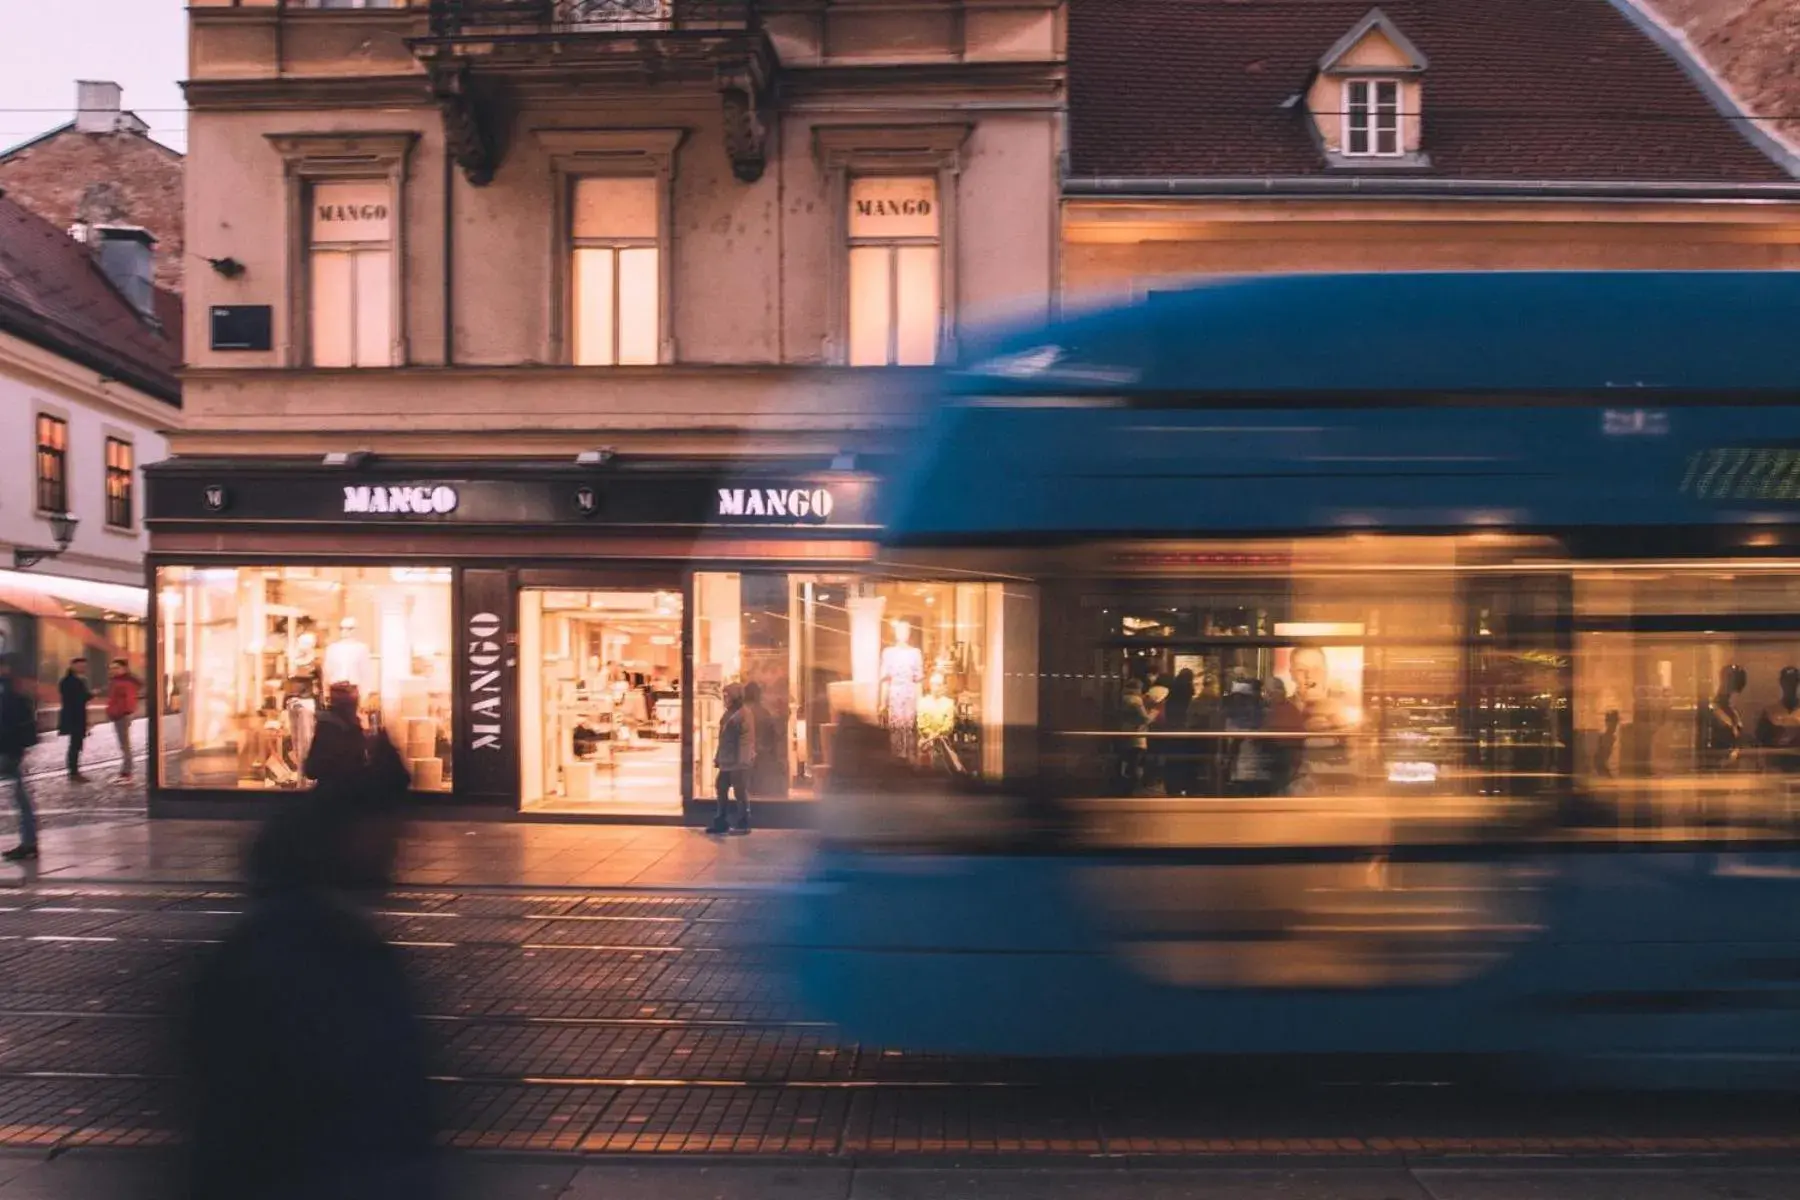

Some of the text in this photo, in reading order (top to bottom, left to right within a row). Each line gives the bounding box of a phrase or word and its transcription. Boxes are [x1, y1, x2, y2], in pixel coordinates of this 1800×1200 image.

[318, 204, 387, 222] MANGO
[857, 199, 931, 216] MANGO
[343, 486, 457, 513] MANGO
[718, 488, 833, 517] MANGO
[469, 612, 501, 750] MANGO
